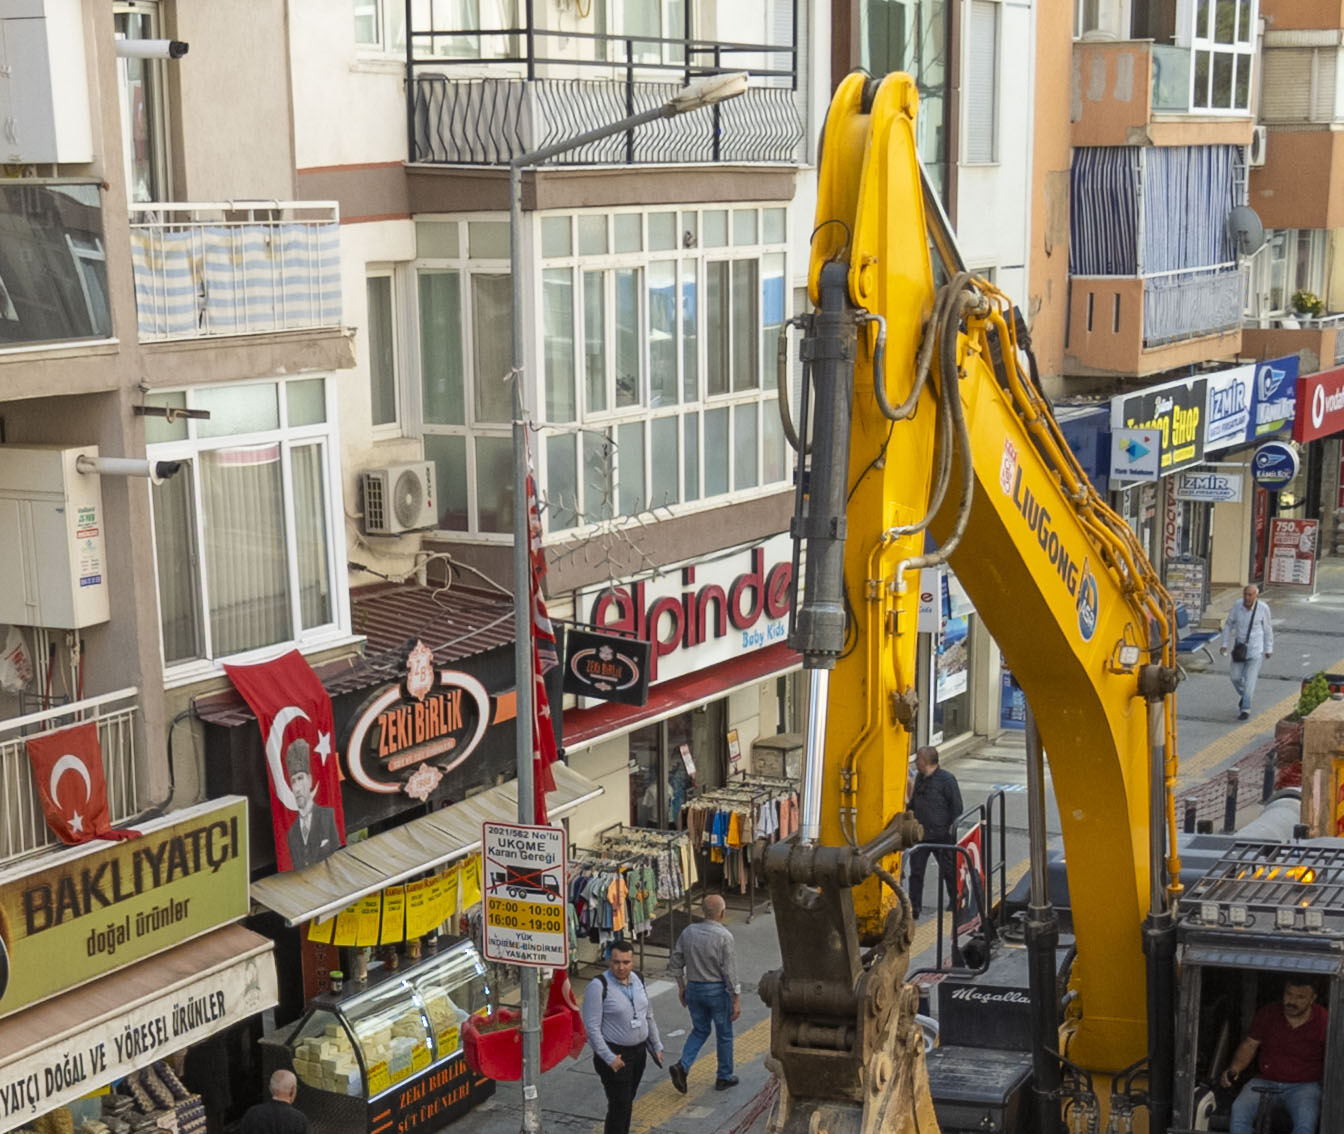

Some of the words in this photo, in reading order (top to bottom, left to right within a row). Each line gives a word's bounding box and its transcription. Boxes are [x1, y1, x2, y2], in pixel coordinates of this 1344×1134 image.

[1208, 377, 1246, 421] İZMİR
[1171, 404, 1200, 446] SHOP
[1180, 475, 1229, 489] İZMİR
[1013, 464, 1079, 597] LIUGONG
[742, 631, 764, 649] Baby
[766, 623, 785, 641] Kids
[488, 826, 529, 839] 2021/562
[497, 838, 546, 852] UKOME
[520, 850, 556, 864] Gereği
[488, 899, 518, 913] 07:00
[529, 904, 561, 918] 10:00
[87, 915, 131, 957] doğal
[136, 898, 191, 938] ürünler
[488, 913, 518, 928] 16:00
[530, 918, 561, 932] 19:00
[504, 948, 547, 961] YASAKTIR
[45, 1053, 87, 1099] DOĞAL
[90, 1042, 107, 1073] VE
[114, 1015, 169, 1064] YÖRESEL
[172, 990, 226, 1037] ÜRÜNLER
